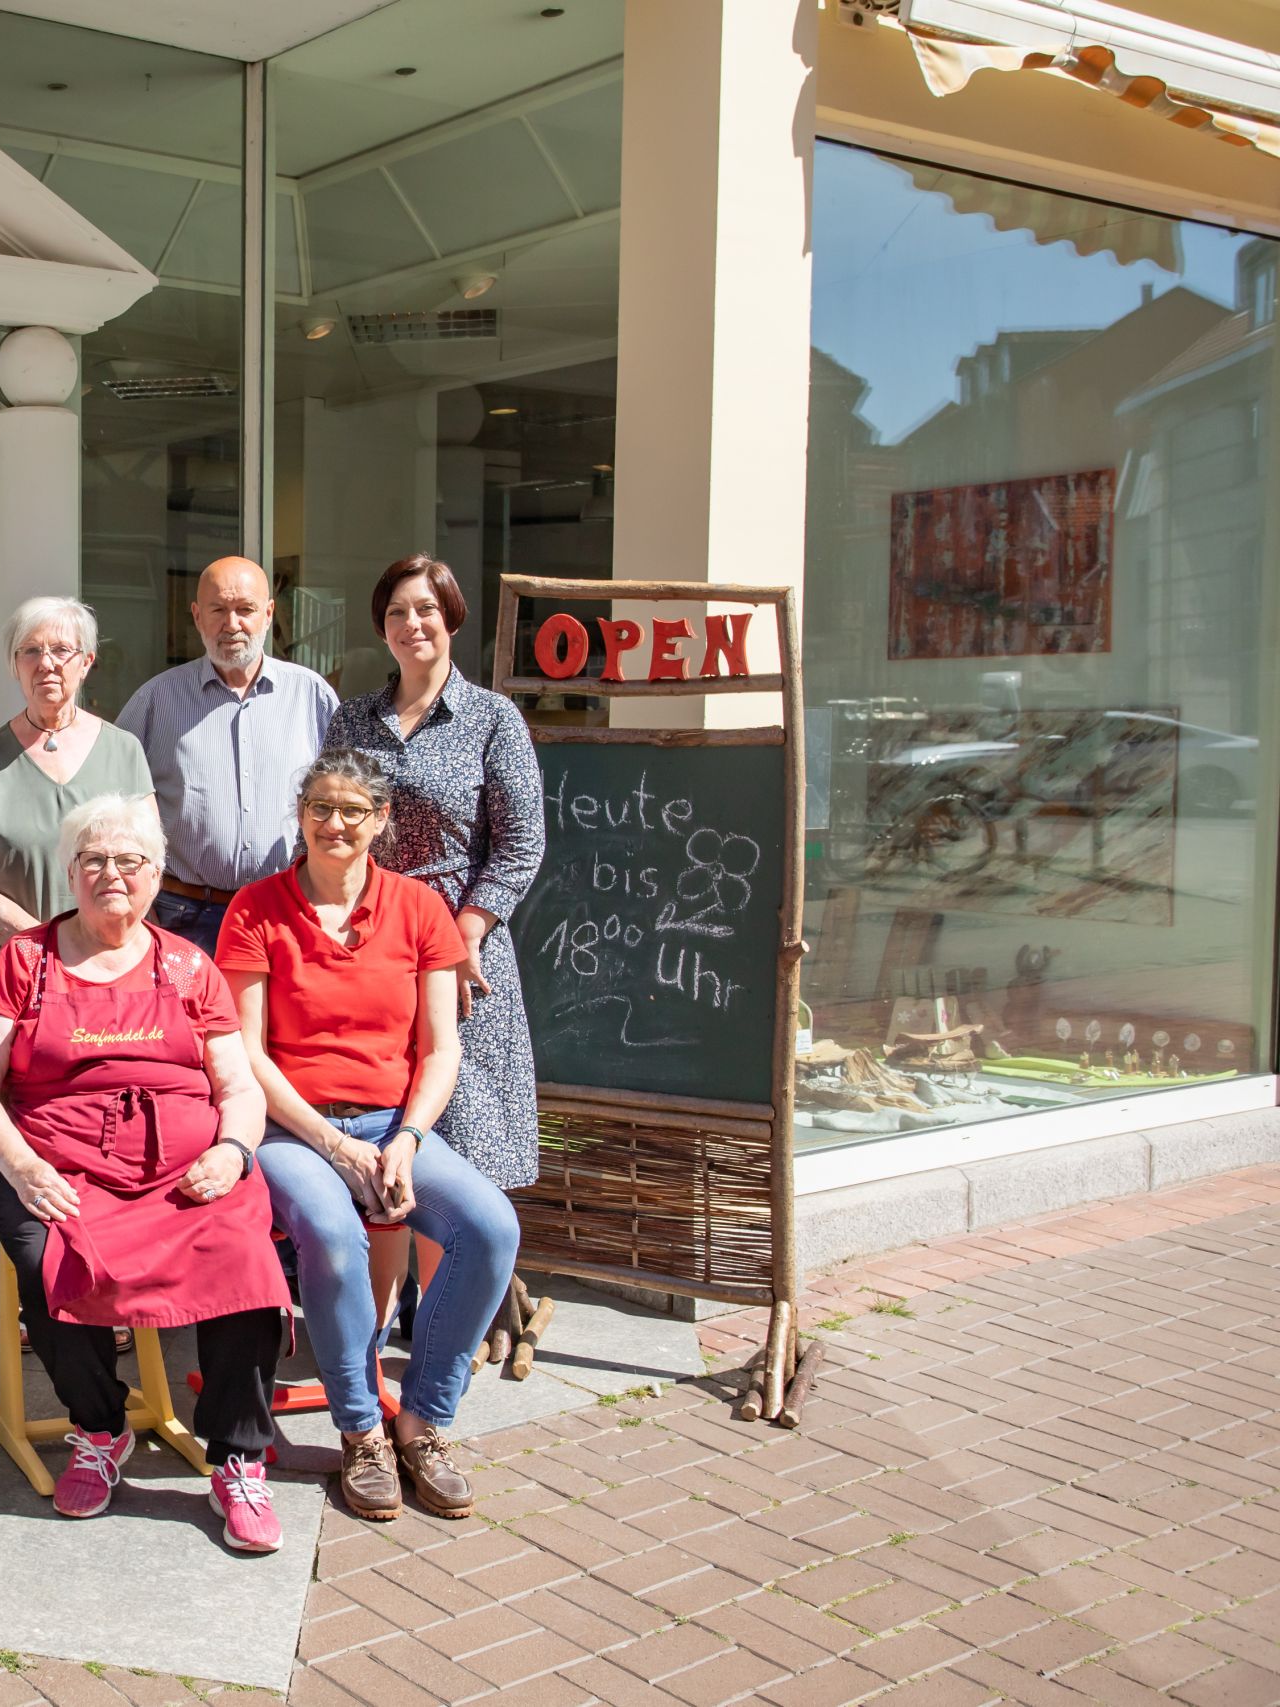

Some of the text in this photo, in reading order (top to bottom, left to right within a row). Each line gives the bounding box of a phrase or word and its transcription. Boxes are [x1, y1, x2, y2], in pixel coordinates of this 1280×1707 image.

[534, 613, 754, 682] OPEN
[541, 769, 693, 835] Heute
[593, 842, 659, 898] bis
[656, 942, 744, 1009] Uhr
[70, 1025, 165, 1047] Senfmadel.de
